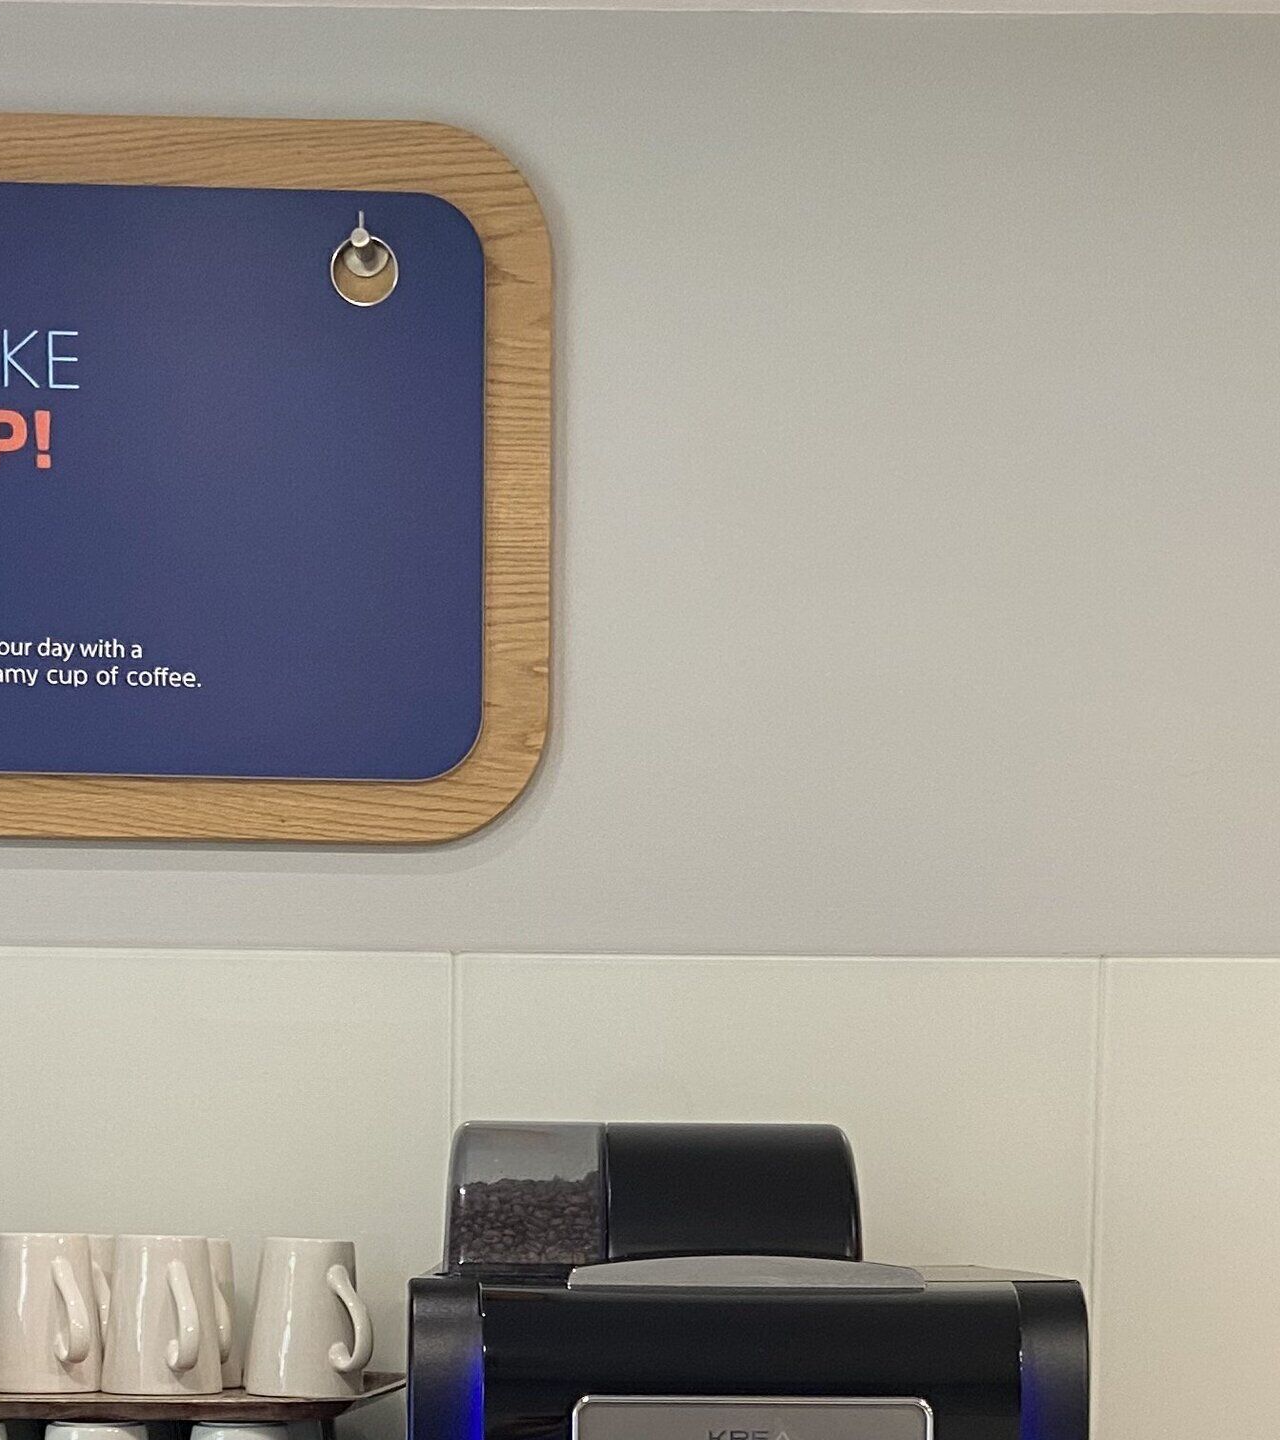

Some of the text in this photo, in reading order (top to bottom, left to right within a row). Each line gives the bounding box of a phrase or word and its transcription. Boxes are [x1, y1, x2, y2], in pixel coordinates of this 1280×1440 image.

[37, 637, 75, 662] day
[79, 639, 125, 658] with
[130, 643, 143, 659] a
[46, 668, 89, 688] cup
[95, 666, 120, 686] of
[126, 667, 202, 688] coffee.
